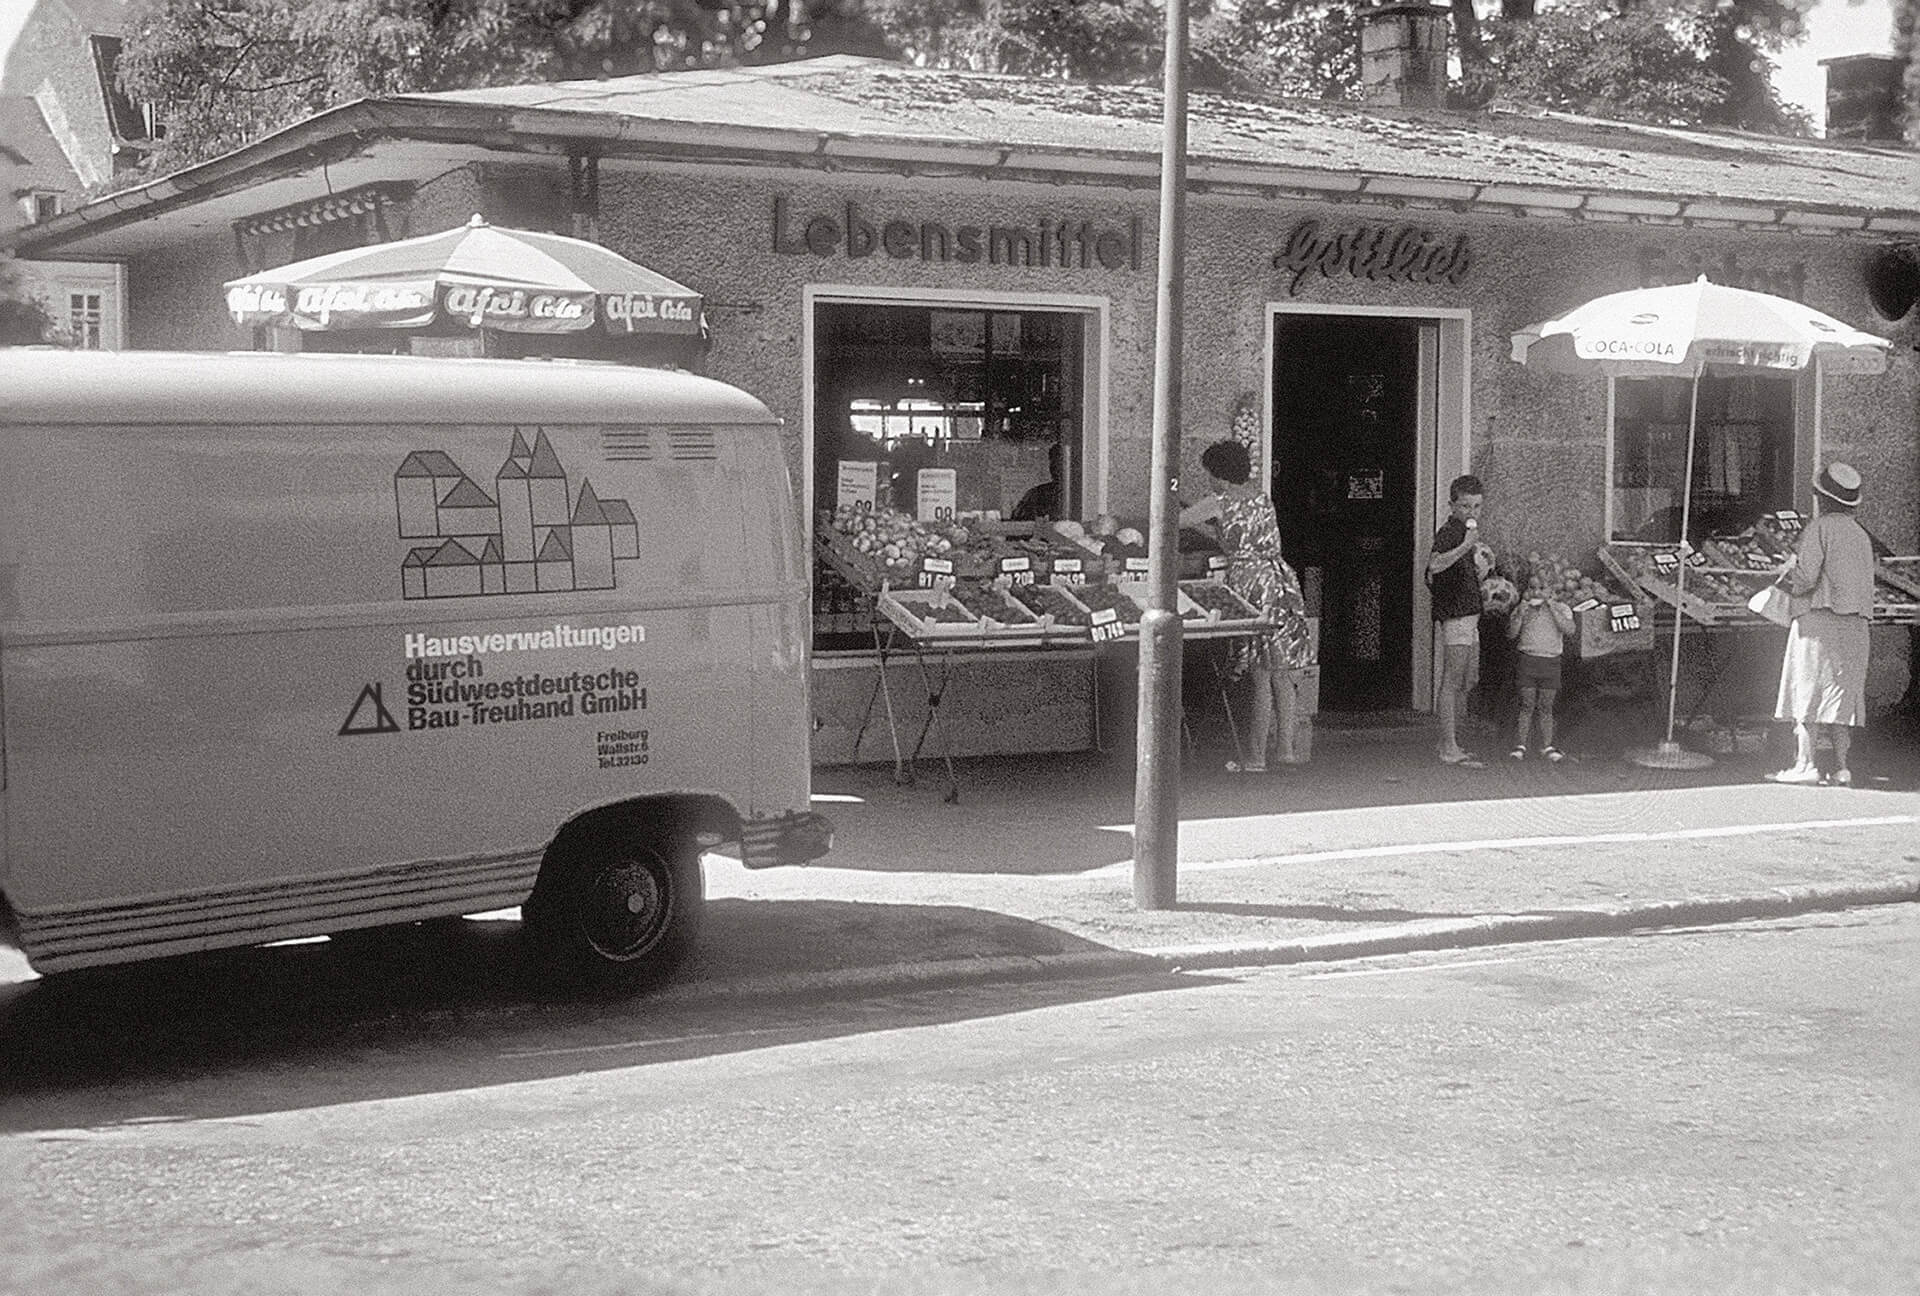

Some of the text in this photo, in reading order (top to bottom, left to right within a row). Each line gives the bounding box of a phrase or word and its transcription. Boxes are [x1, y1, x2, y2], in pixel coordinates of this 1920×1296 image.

[774, 195, 1142, 271] Lebensmittel
[1170, 478, 1178, 491] 2
[404, 624, 646, 658] Hausverwaltungen
[406, 655, 483, 681] durch
[407, 667, 639, 706] Südwestdeutsche
[408, 688, 647, 730] Bau-Treuhand GmbH
[597, 729, 649, 743] Freiburg
